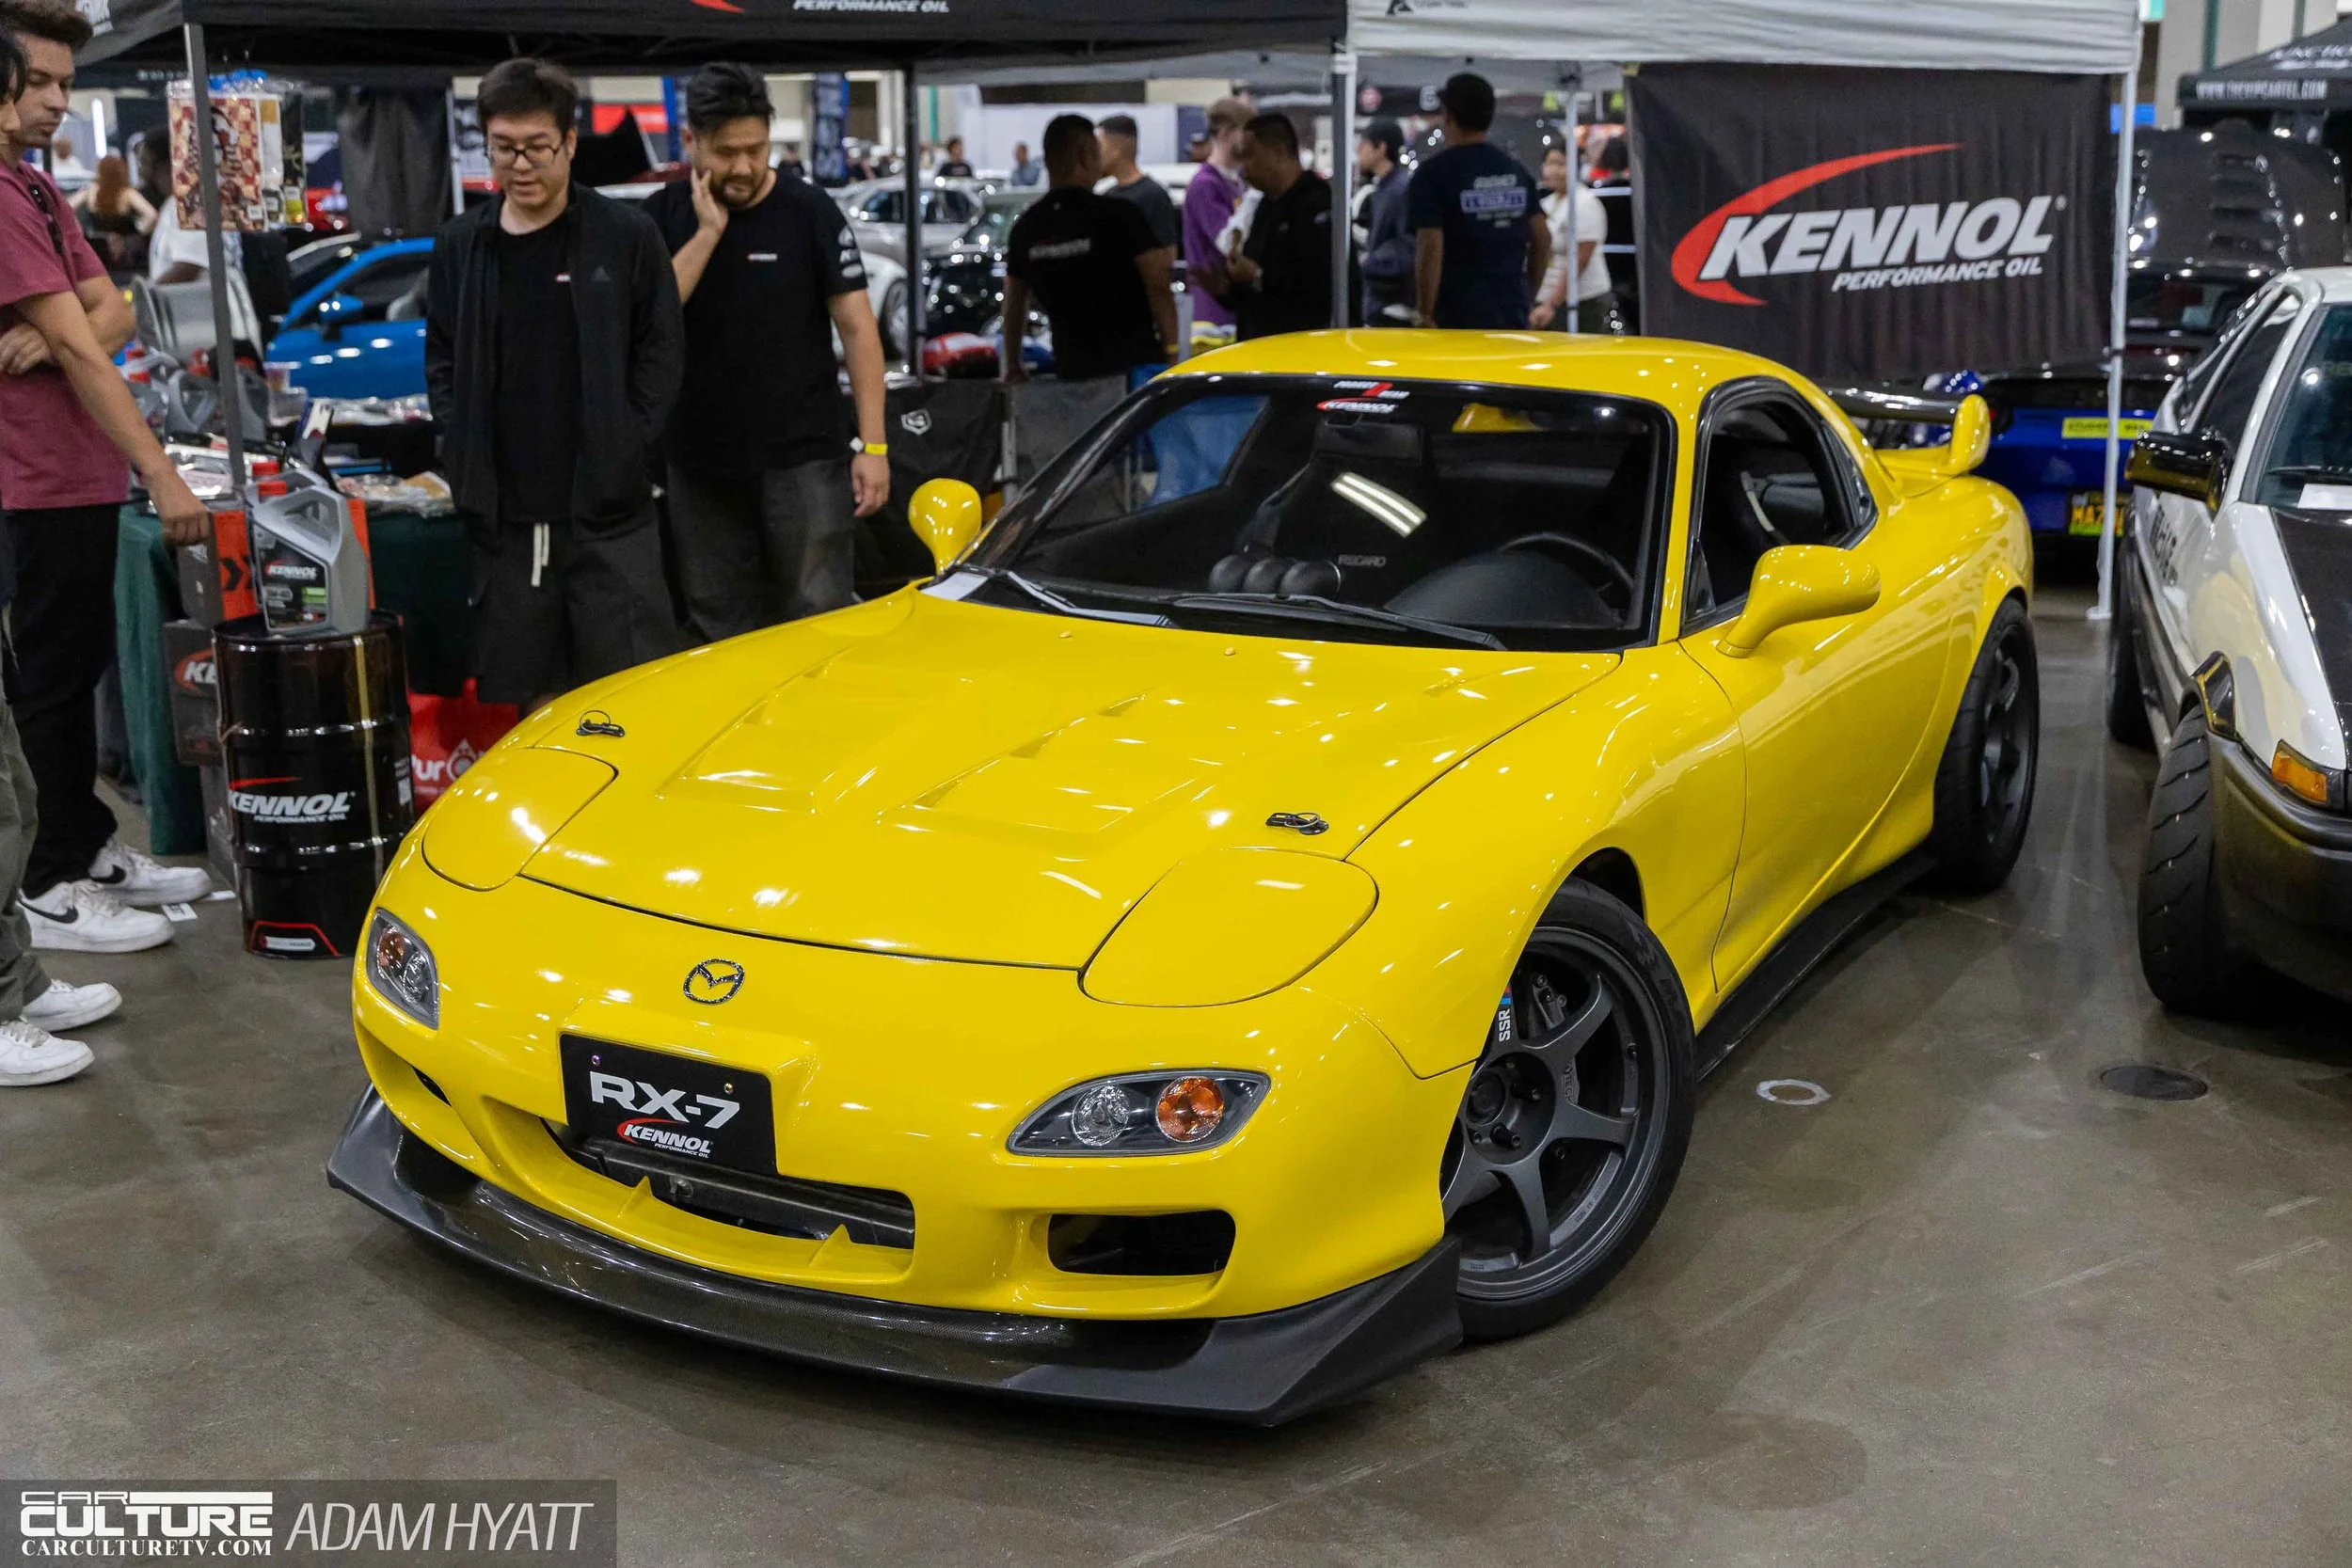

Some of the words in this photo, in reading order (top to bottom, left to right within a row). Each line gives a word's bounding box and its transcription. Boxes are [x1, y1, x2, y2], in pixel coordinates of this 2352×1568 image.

[793, 0, 919, 12] PERFORMANCE
[920, 1, 949, 13] OIL
[1699, 196, 2054, 280] KENNOL
[1831, 261, 2003, 293] PERFORMANCE
[2005, 258, 2043, 277] OIL
[228, 791, 351, 816] KENNOL
[253, 815, 327, 824] PERFORMANCE
[328, 813, 346, 821] OIL
[1499, 1008, 1511, 1042] SSR
[590, 1071, 740, 1129] RX-7
[624, 1124, 712, 1153] KENNOL
[655, 1143, 698, 1157] PERFORMANCE
